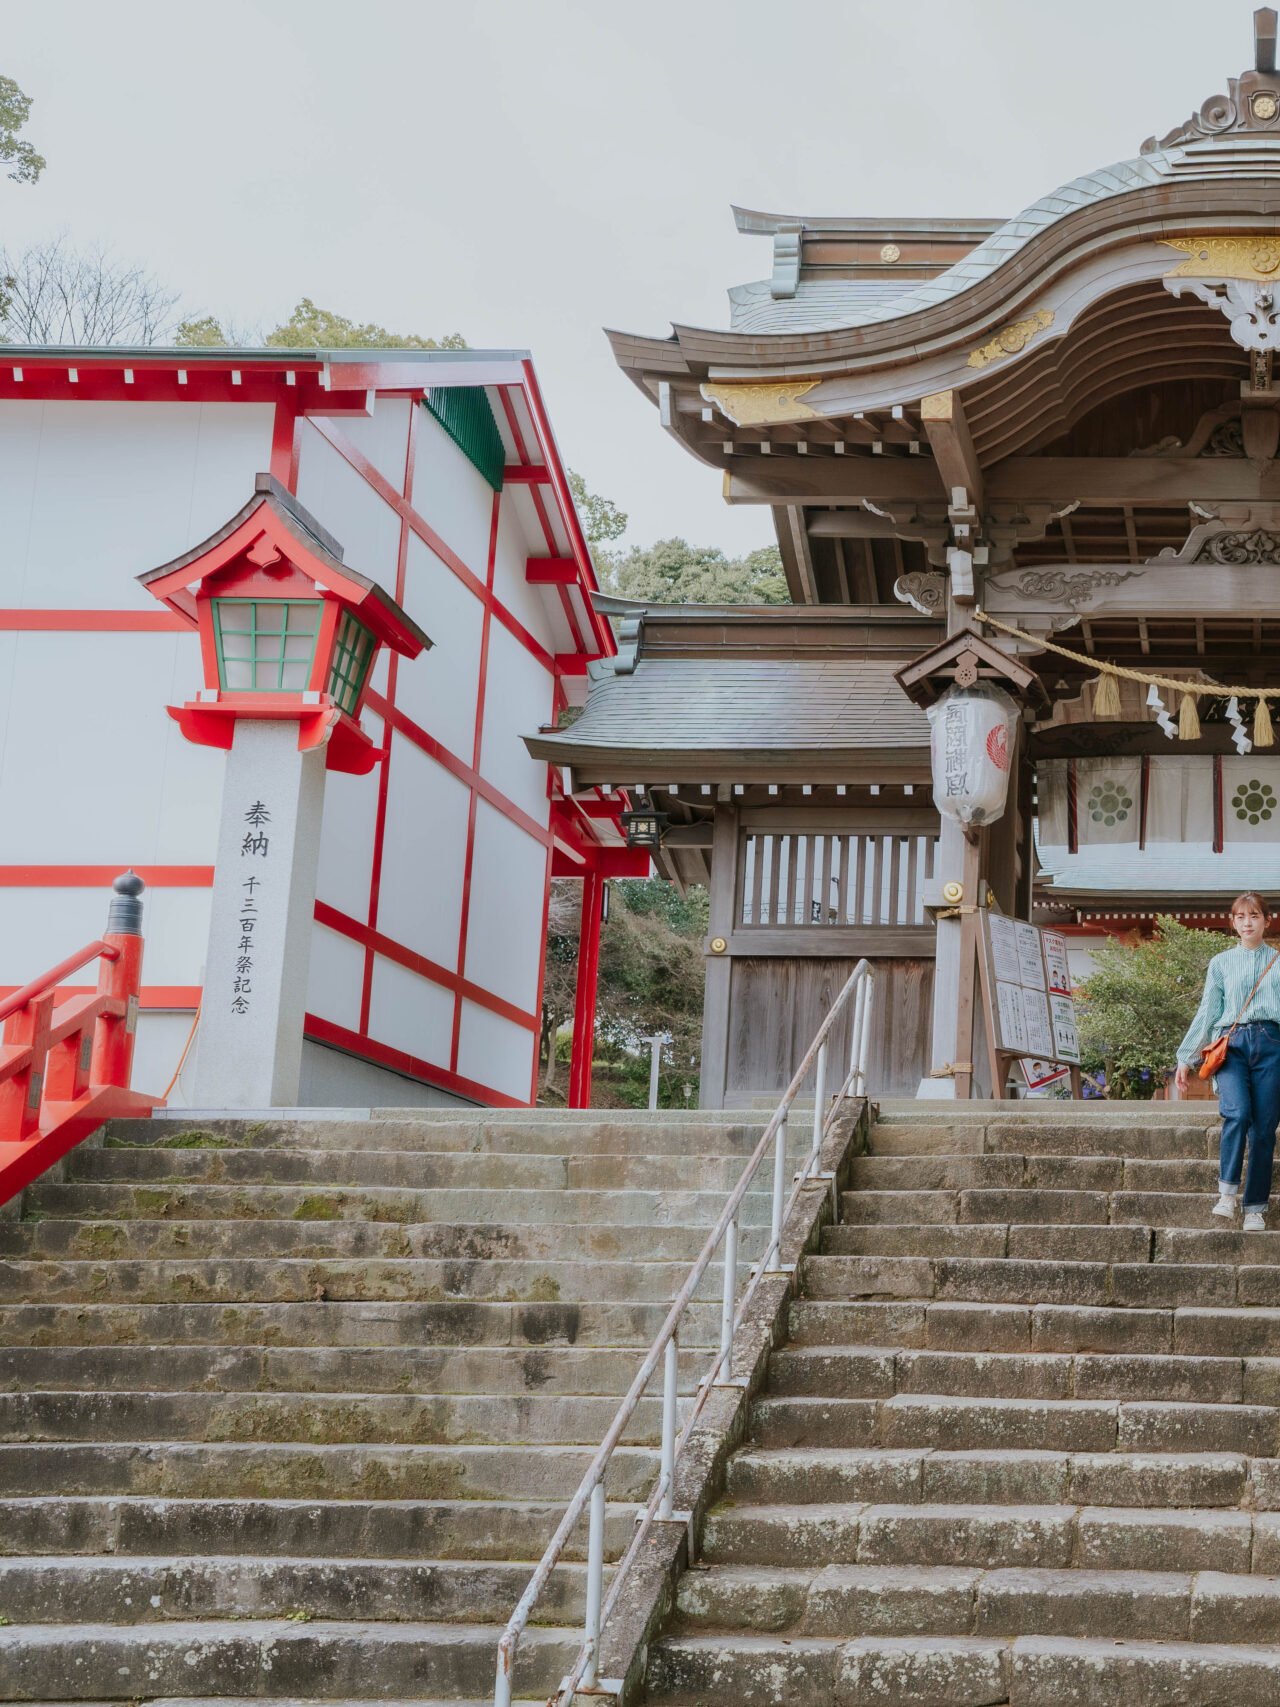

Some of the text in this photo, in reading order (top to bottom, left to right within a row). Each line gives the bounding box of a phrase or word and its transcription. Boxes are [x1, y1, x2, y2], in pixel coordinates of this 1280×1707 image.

[231, 800, 272, 1015] 奉納 千三百年祭記念
